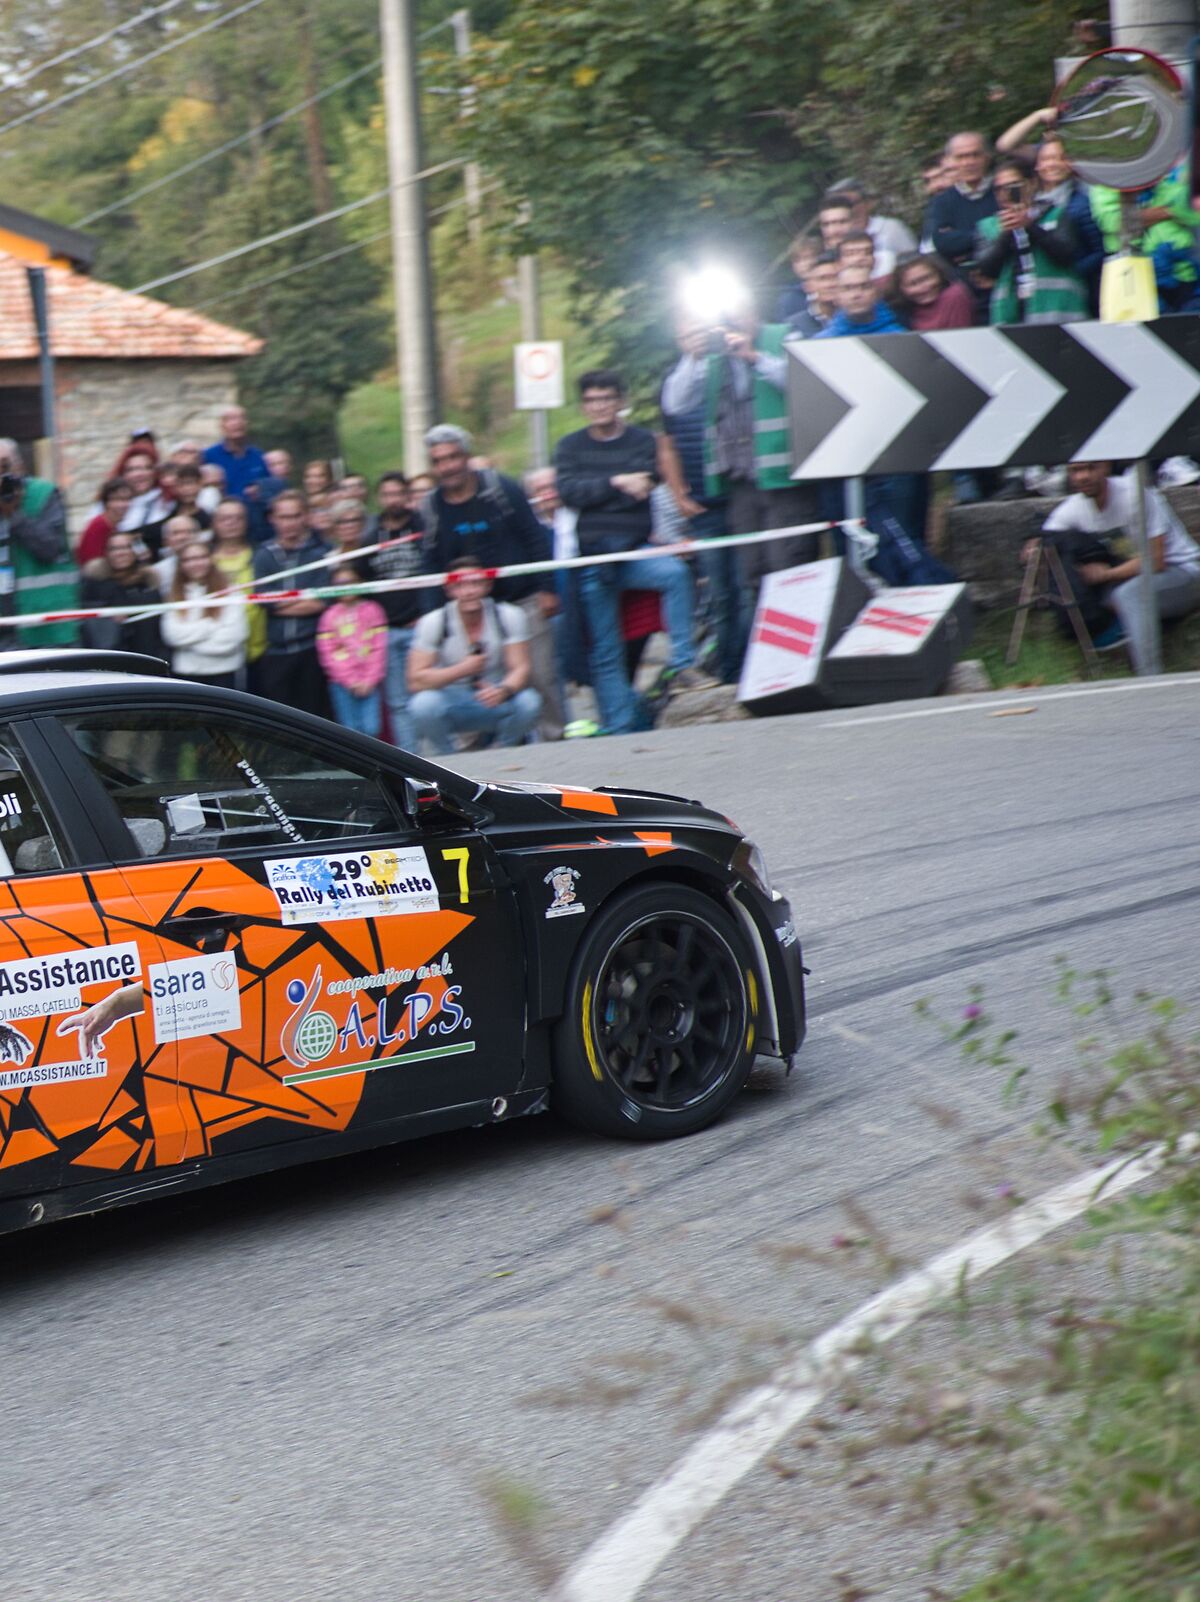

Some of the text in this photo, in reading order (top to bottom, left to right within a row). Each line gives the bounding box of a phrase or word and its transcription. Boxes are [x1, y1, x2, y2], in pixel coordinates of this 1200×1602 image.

[441, 847, 470, 904] 7
[275, 876, 432, 905] Rally del Rubinetto
[153, 970, 206, 998] sara
[327, 966, 415, 999] cooperativa
[9, 1004, 41, 1019] MASSA
[42, 996, 80, 1014] CATELLO
[156, 999, 208, 1016] ti assicura
[340, 985, 472, 1053] A.L.P.S.
